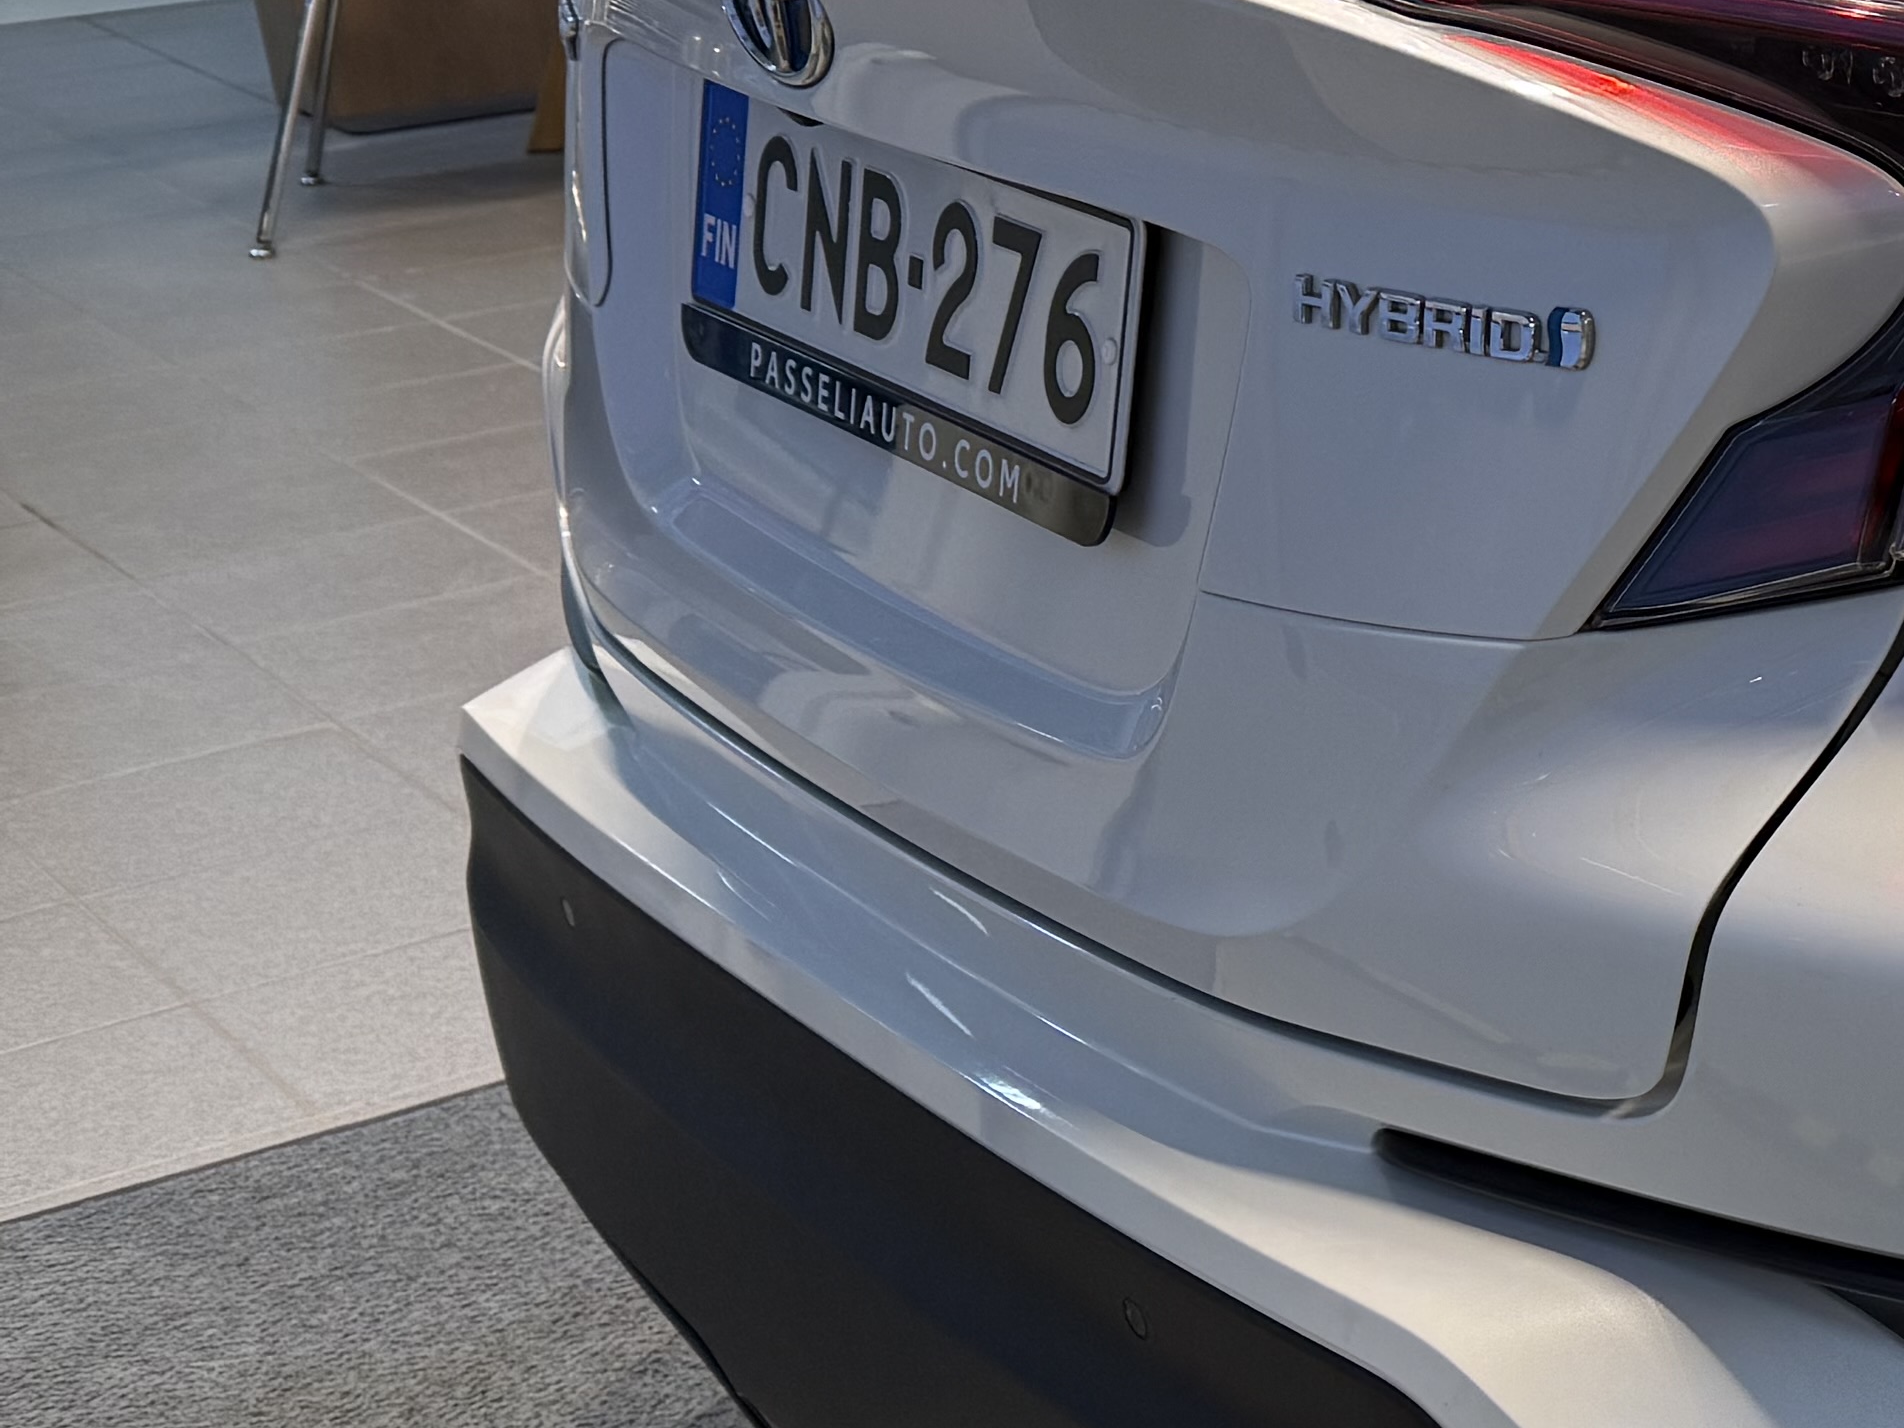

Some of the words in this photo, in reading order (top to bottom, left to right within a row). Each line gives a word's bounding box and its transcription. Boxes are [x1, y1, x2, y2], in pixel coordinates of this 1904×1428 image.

[700, 212, 738, 269] FIN
[752, 134, 1101, 426] CNB-276
[1292, 272, 1545, 364] HYBRID
[748, 341, 1022, 505] PASSELIAUTO.COM
